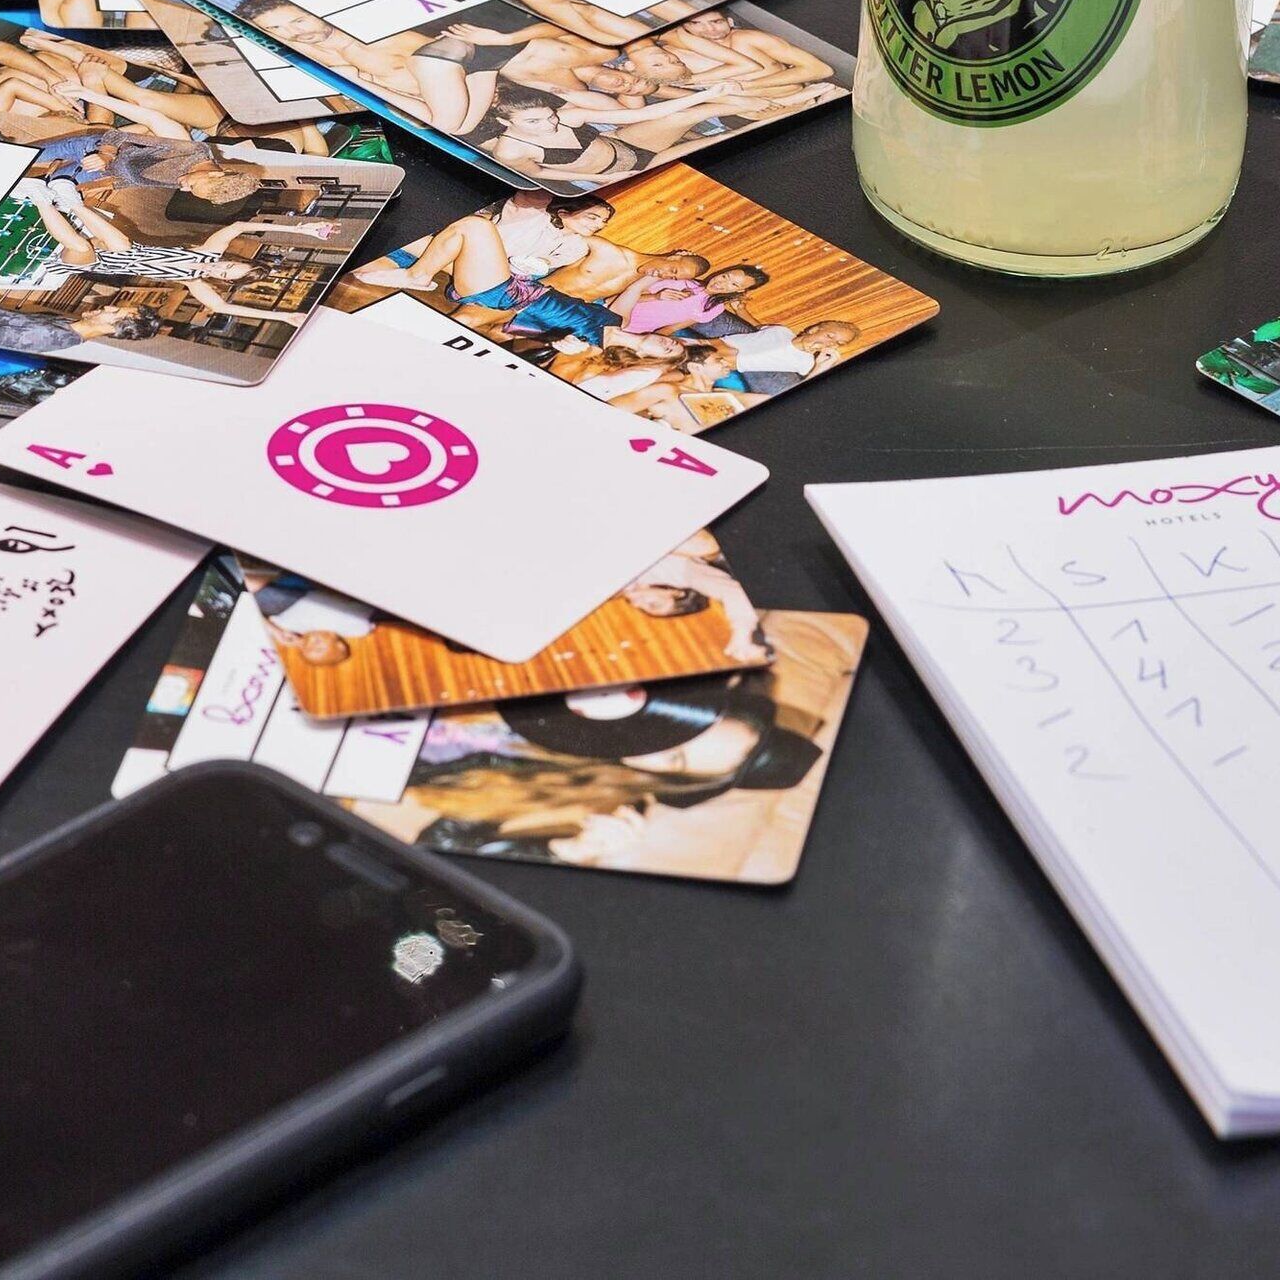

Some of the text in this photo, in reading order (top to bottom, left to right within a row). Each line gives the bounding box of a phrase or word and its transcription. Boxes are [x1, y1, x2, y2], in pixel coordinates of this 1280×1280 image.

[955, 49, 1066, 103] LEMON
[26, 441, 87, 470] A
[656, 447, 718, 478] A
[1145, 511, 1223, 527] HOTELS
[1137, 656, 1168, 690] 4
